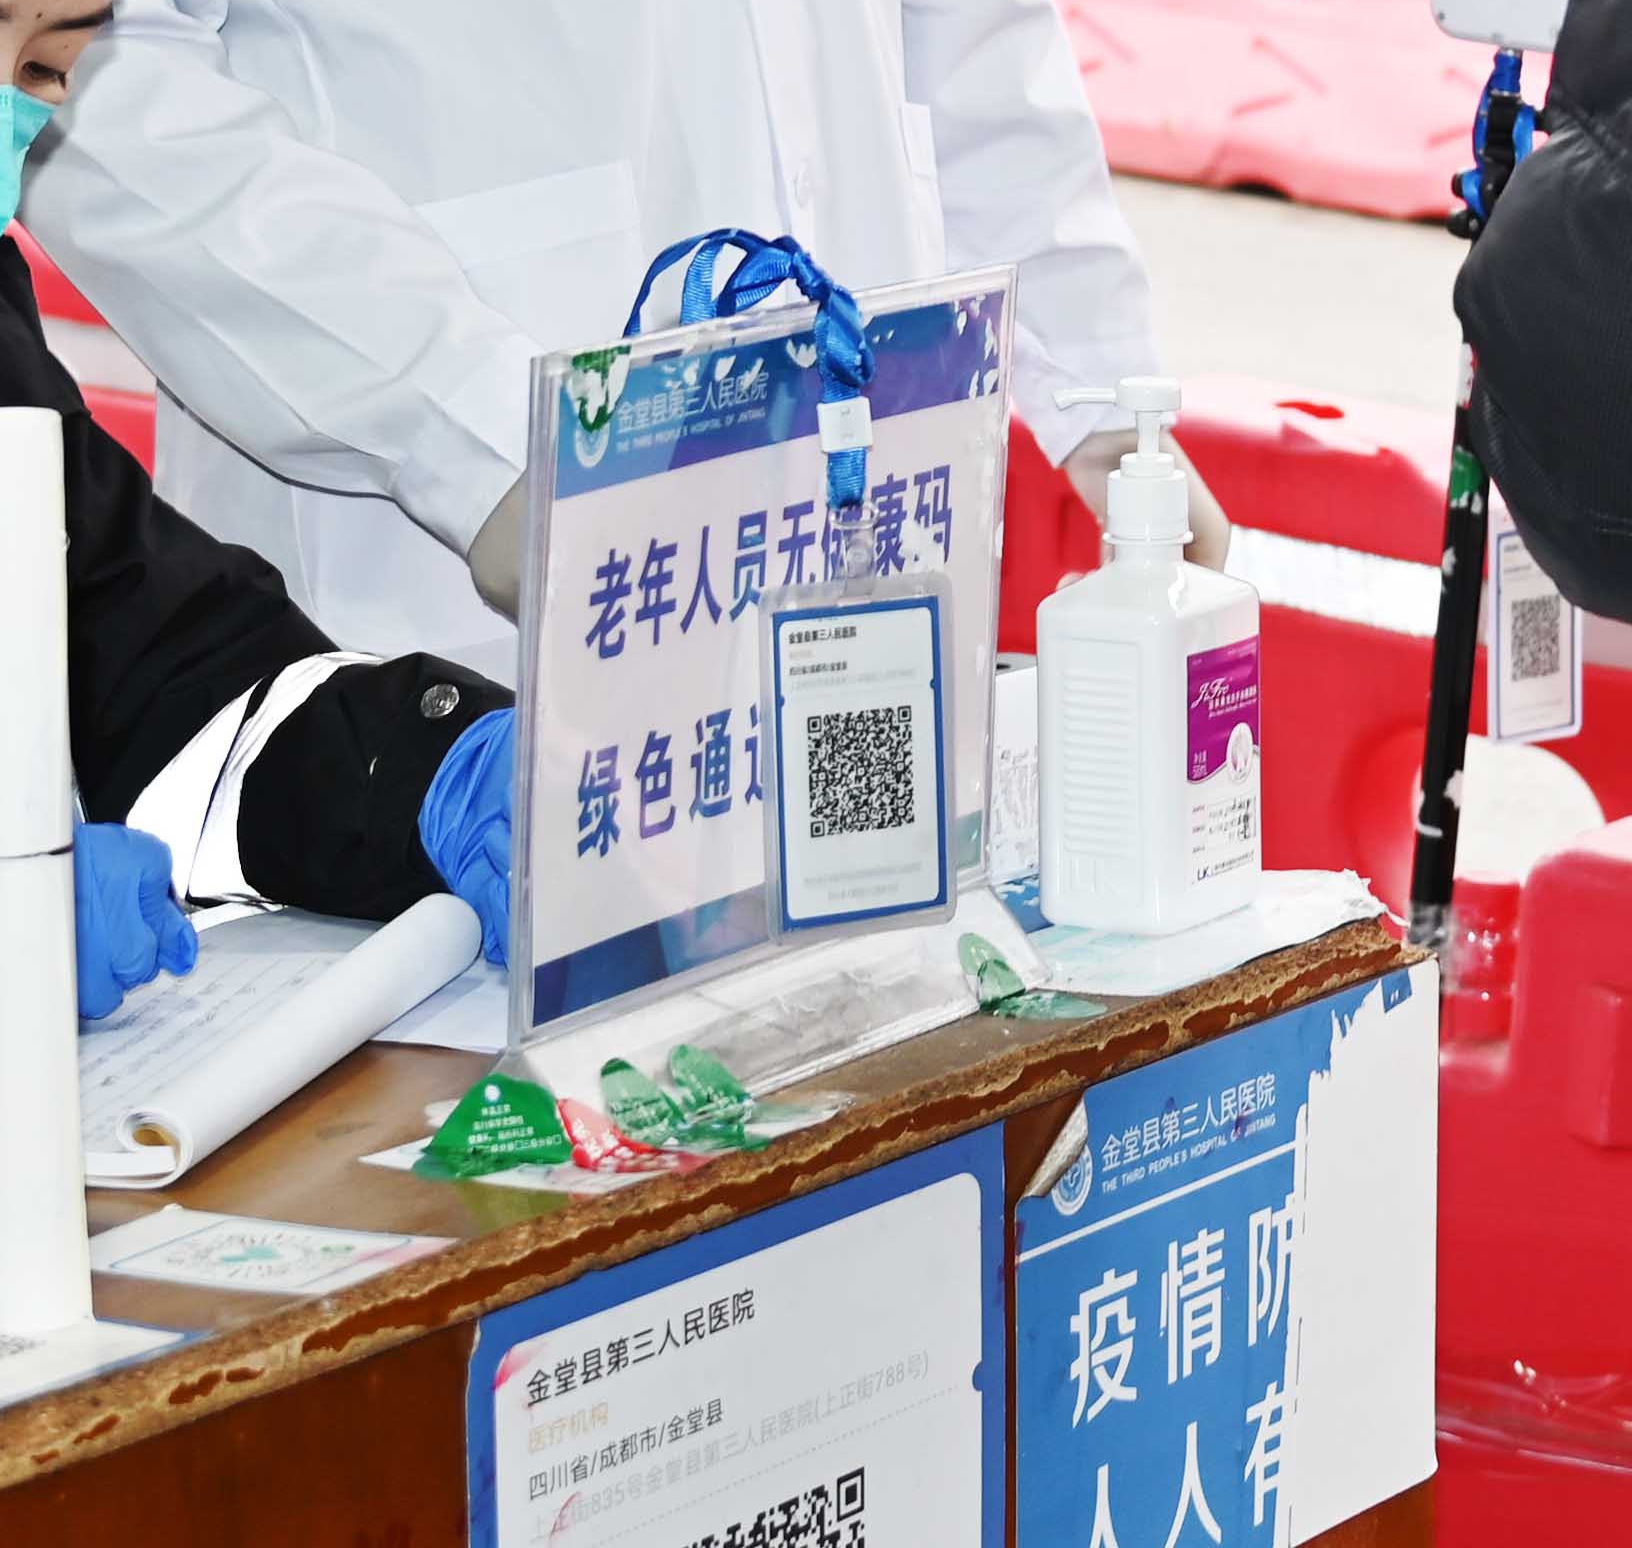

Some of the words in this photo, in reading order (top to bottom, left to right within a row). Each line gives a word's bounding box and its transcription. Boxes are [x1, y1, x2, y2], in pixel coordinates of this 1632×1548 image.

[1101, 1072, 1276, 1173] 金堂县第三人民医院
[1102, 1178, 1118, 1194] THE
[1121, 1166, 1146, 1187] THIRD
[1190, 1134, 1228, 1158] HOSPITAL
[526, 1287, 757, 1409] 金堂县第三人民医院
[1070, 1206, 1296, 1429] 疫情防
[527, 1402, 610, 1455] 医疗机构
[528, 1397, 725, 1502] 四川省/成都市/金堂县
